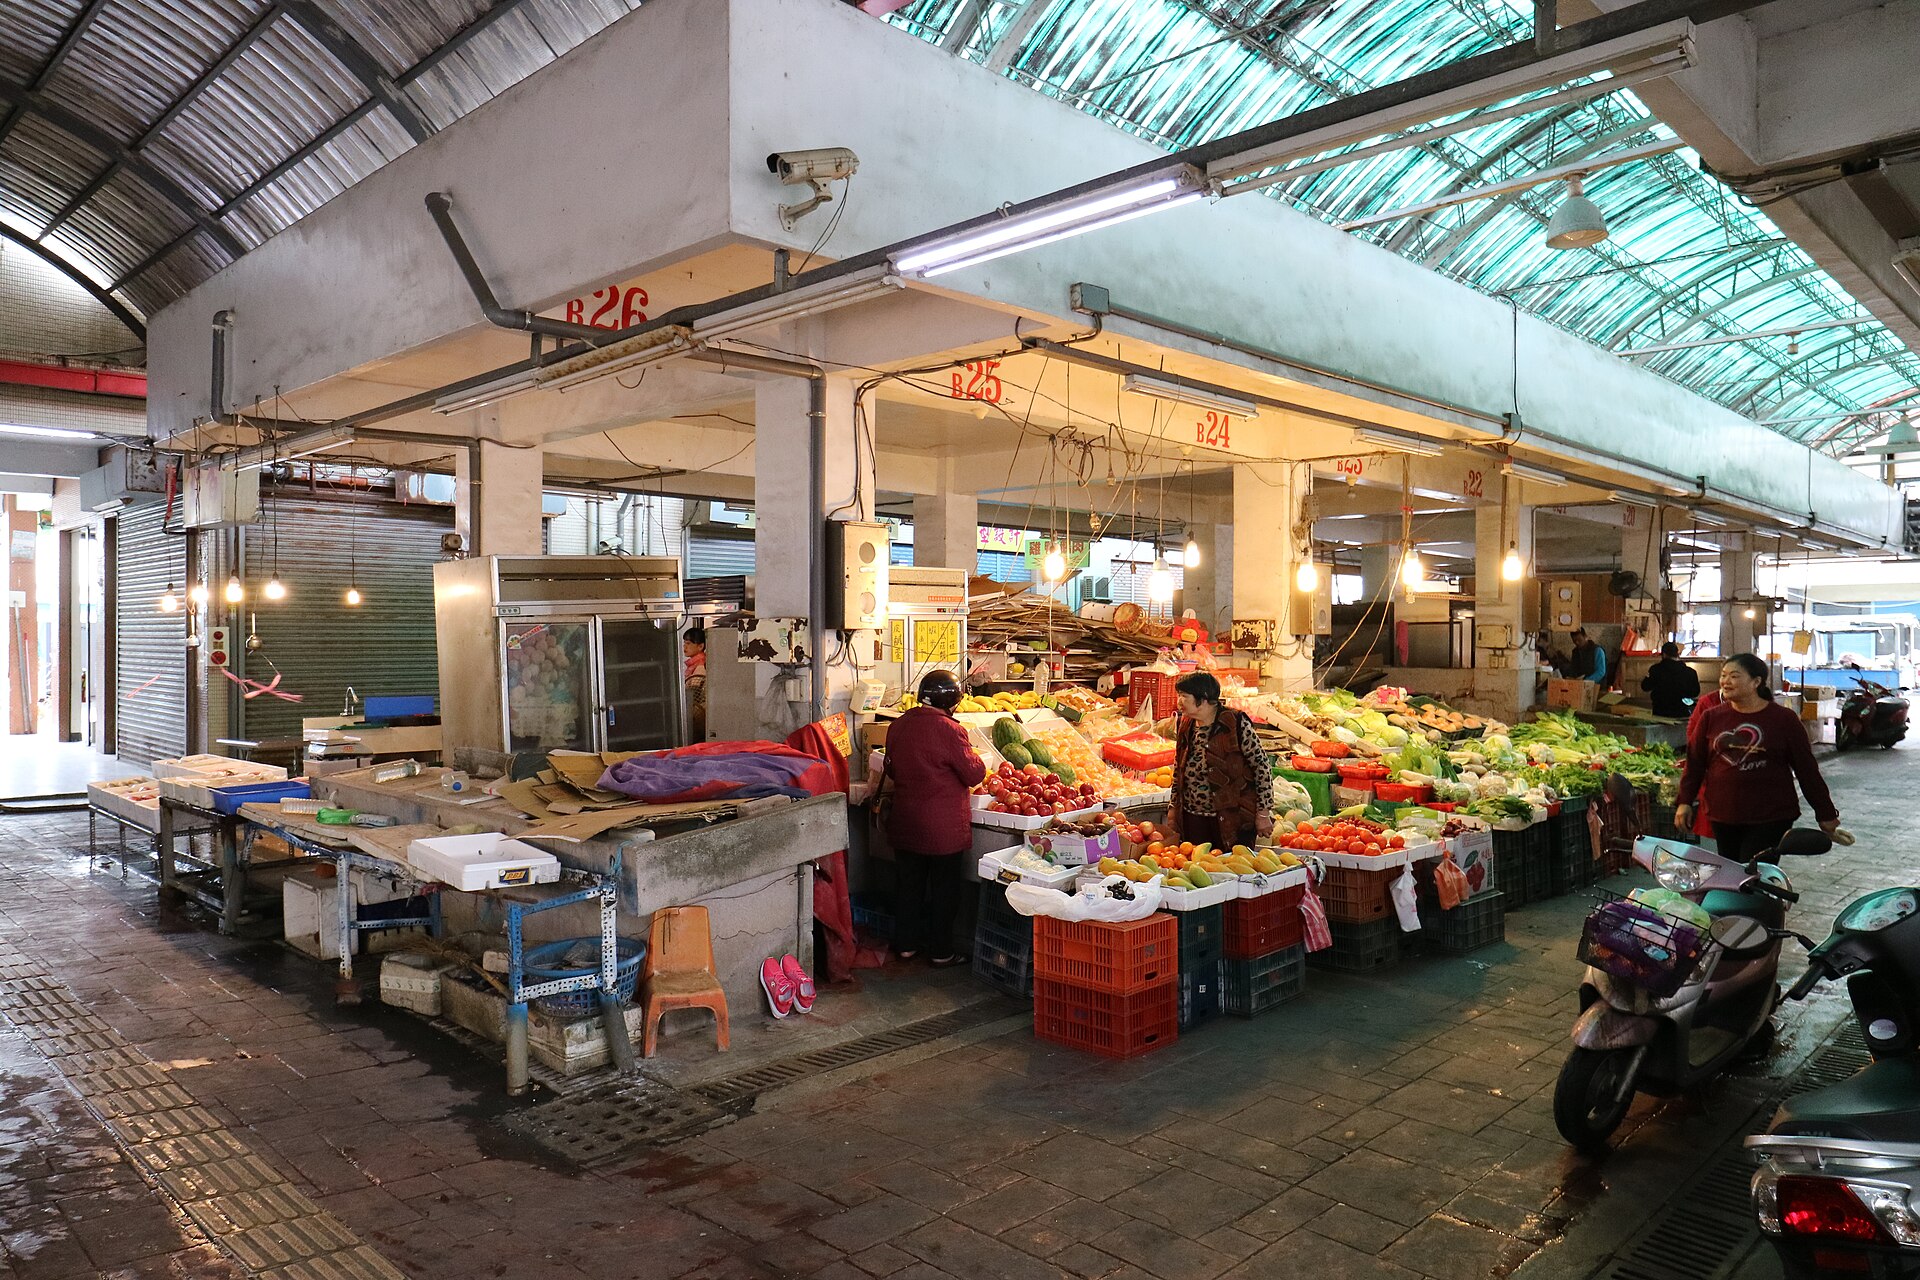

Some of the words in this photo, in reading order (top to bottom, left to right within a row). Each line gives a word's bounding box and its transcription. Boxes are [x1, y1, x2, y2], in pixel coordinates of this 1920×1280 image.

[567, 285, 648, 331] B26
[952, 361, 1001, 403] B25
[1197, 411, 1230, 448] B24
[1463, 470, 1482, 498] B22
